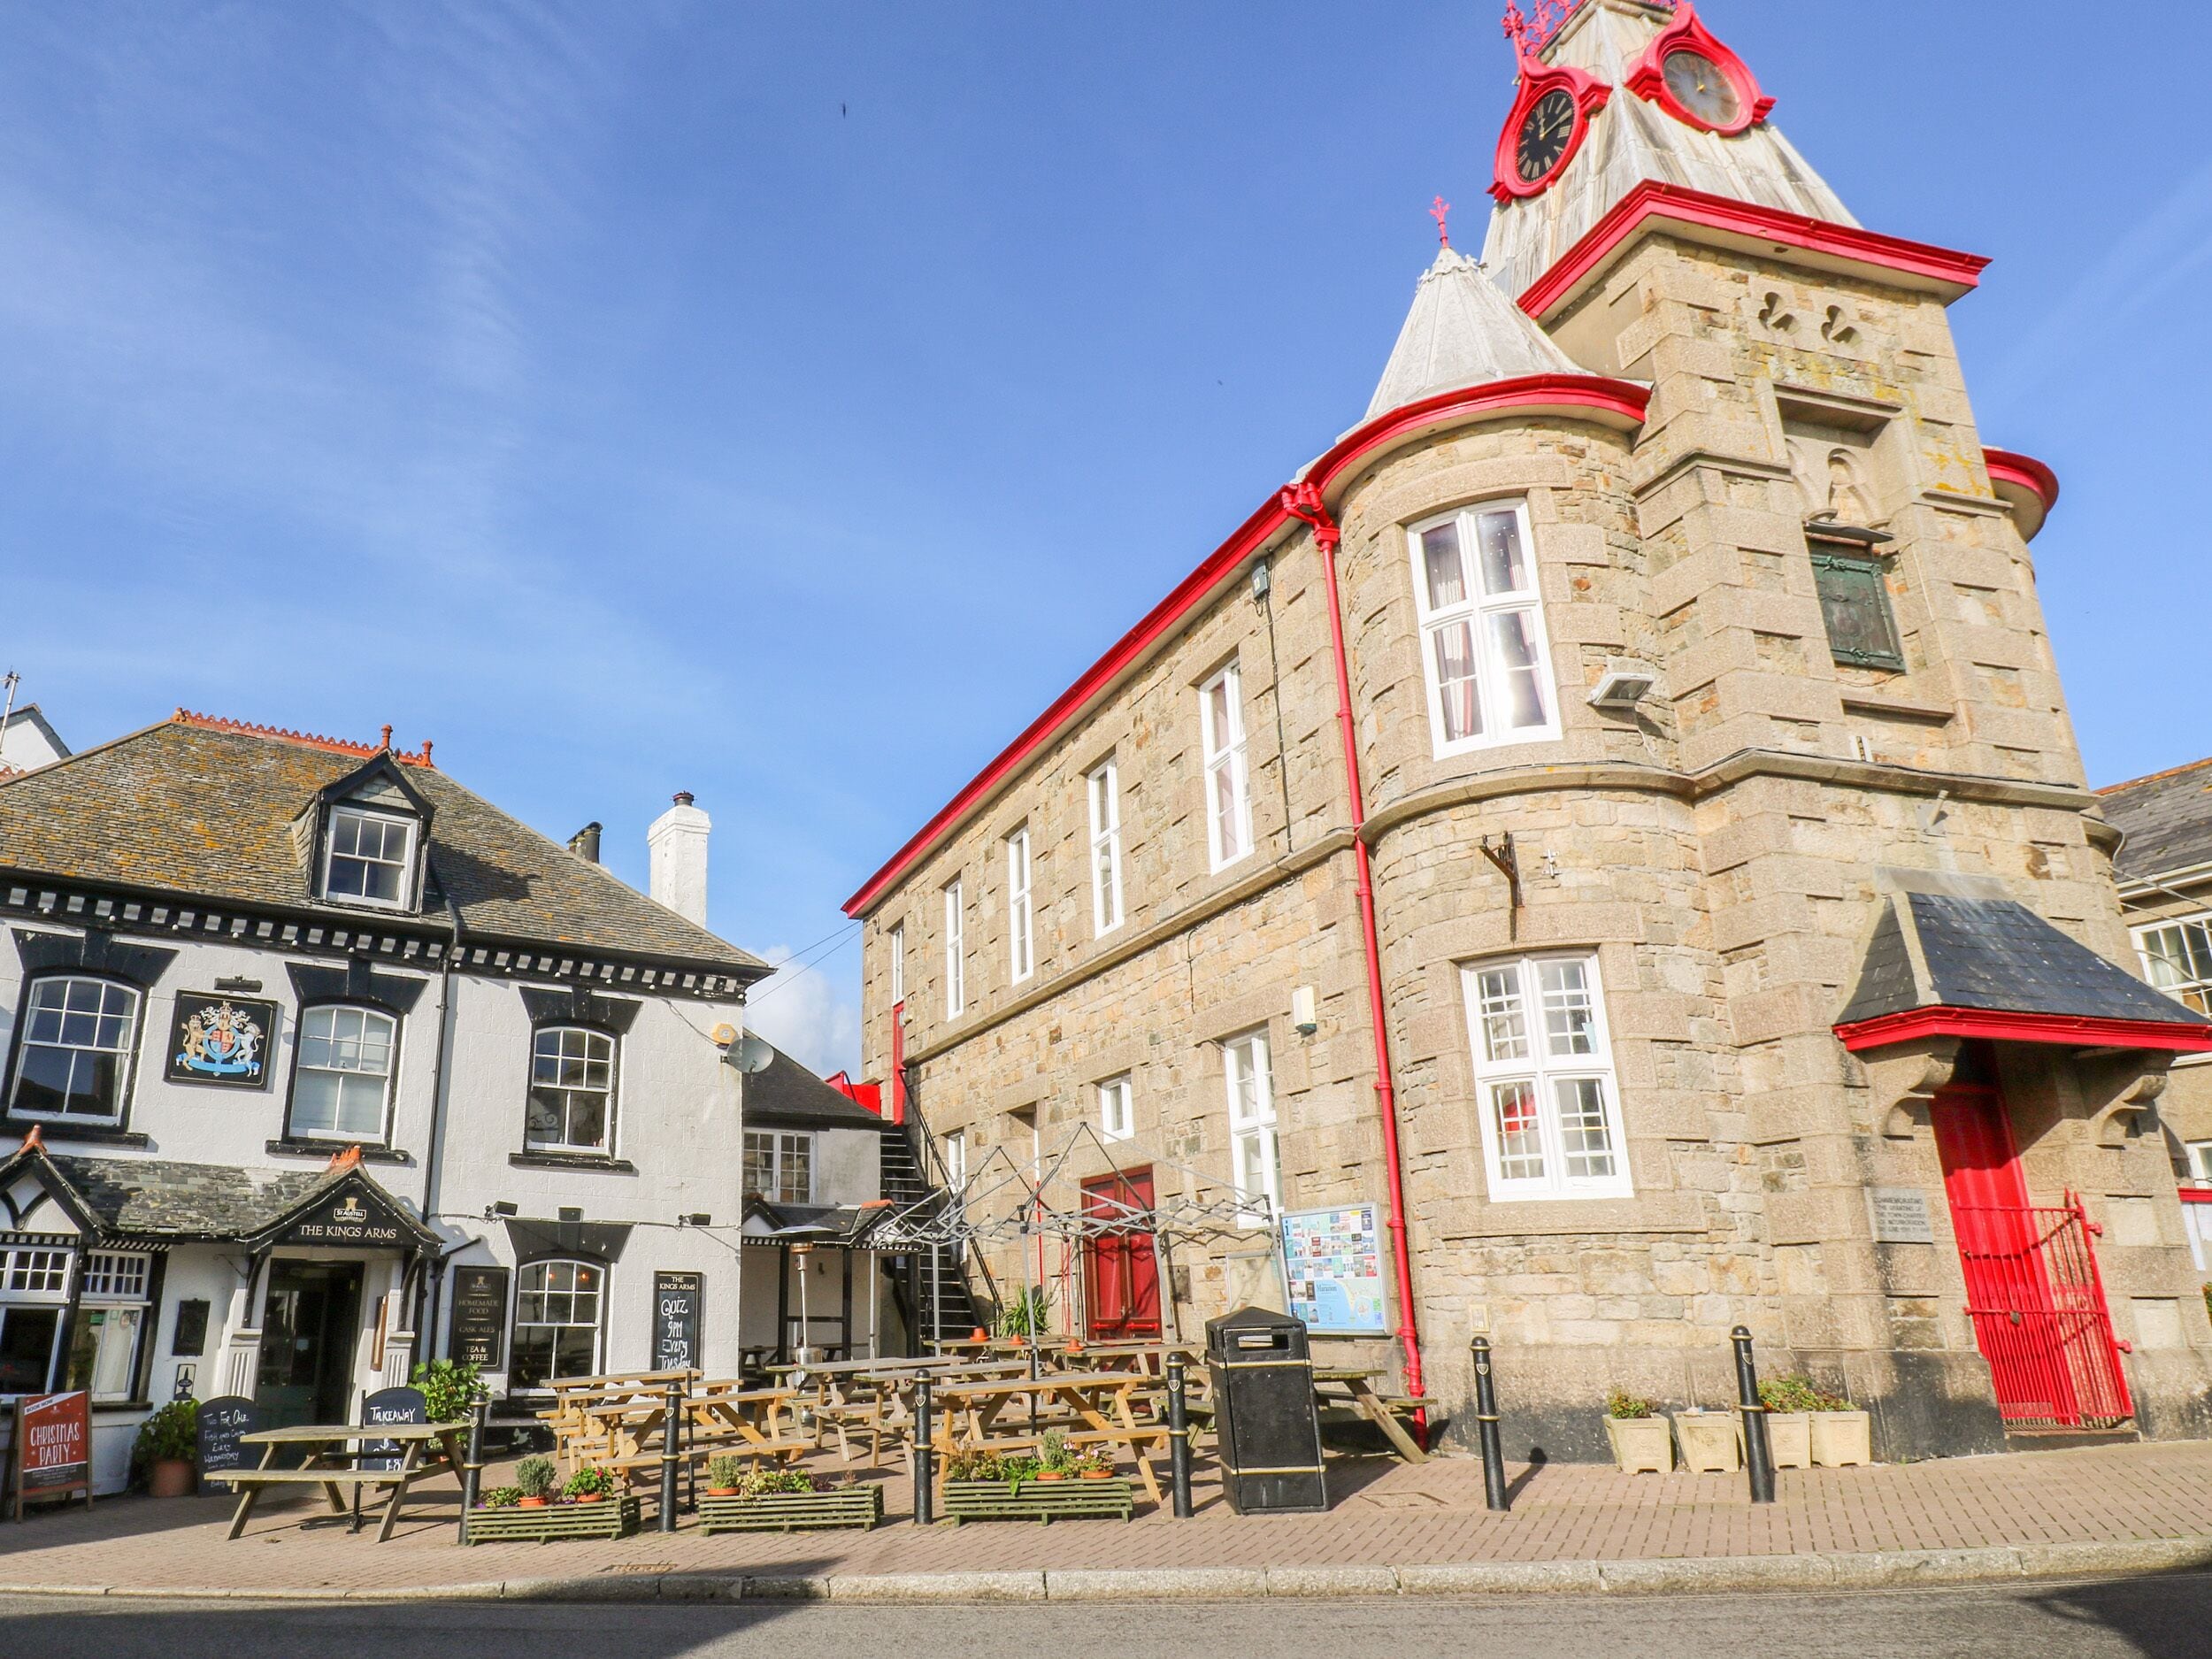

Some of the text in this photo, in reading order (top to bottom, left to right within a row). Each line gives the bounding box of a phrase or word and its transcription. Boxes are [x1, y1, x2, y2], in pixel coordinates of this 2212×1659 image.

[300, 1225, 396, 1238] THE KINGS ARMS
[30, 1422, 80, 1447] CHRISTMAS
[39, 1443, 71, 1466] PARTY
